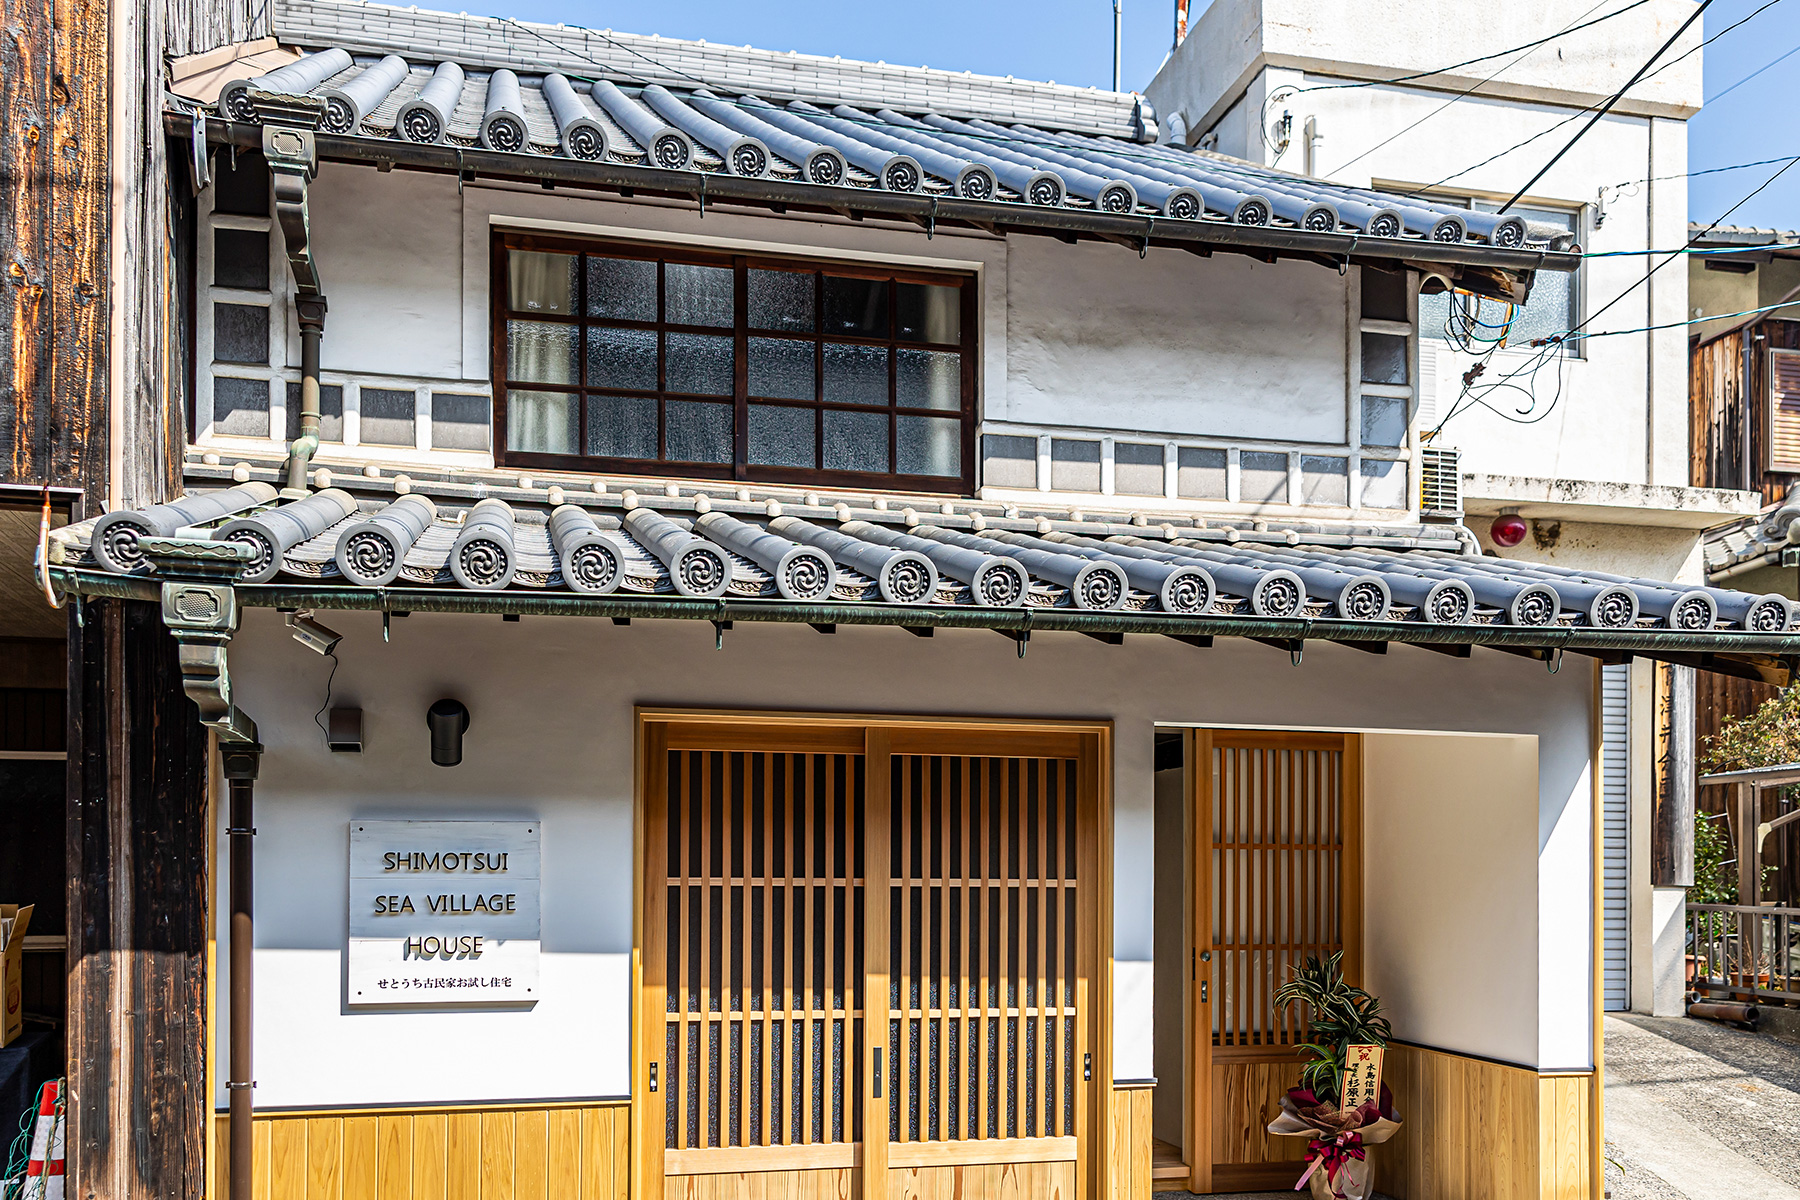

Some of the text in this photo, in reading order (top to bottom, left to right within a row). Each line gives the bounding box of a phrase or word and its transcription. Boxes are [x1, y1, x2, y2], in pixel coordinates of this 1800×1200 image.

[384, 852, 509, 871] SHIMOTSUI
[374, 893, 517, 914] SEA VILLAGE
[407, 936, 484, 955] HOUSE
[377, 976, 512, 989] せとうち古民家お試し住宅
[1359, 1052, 1370, 1061] 祝
